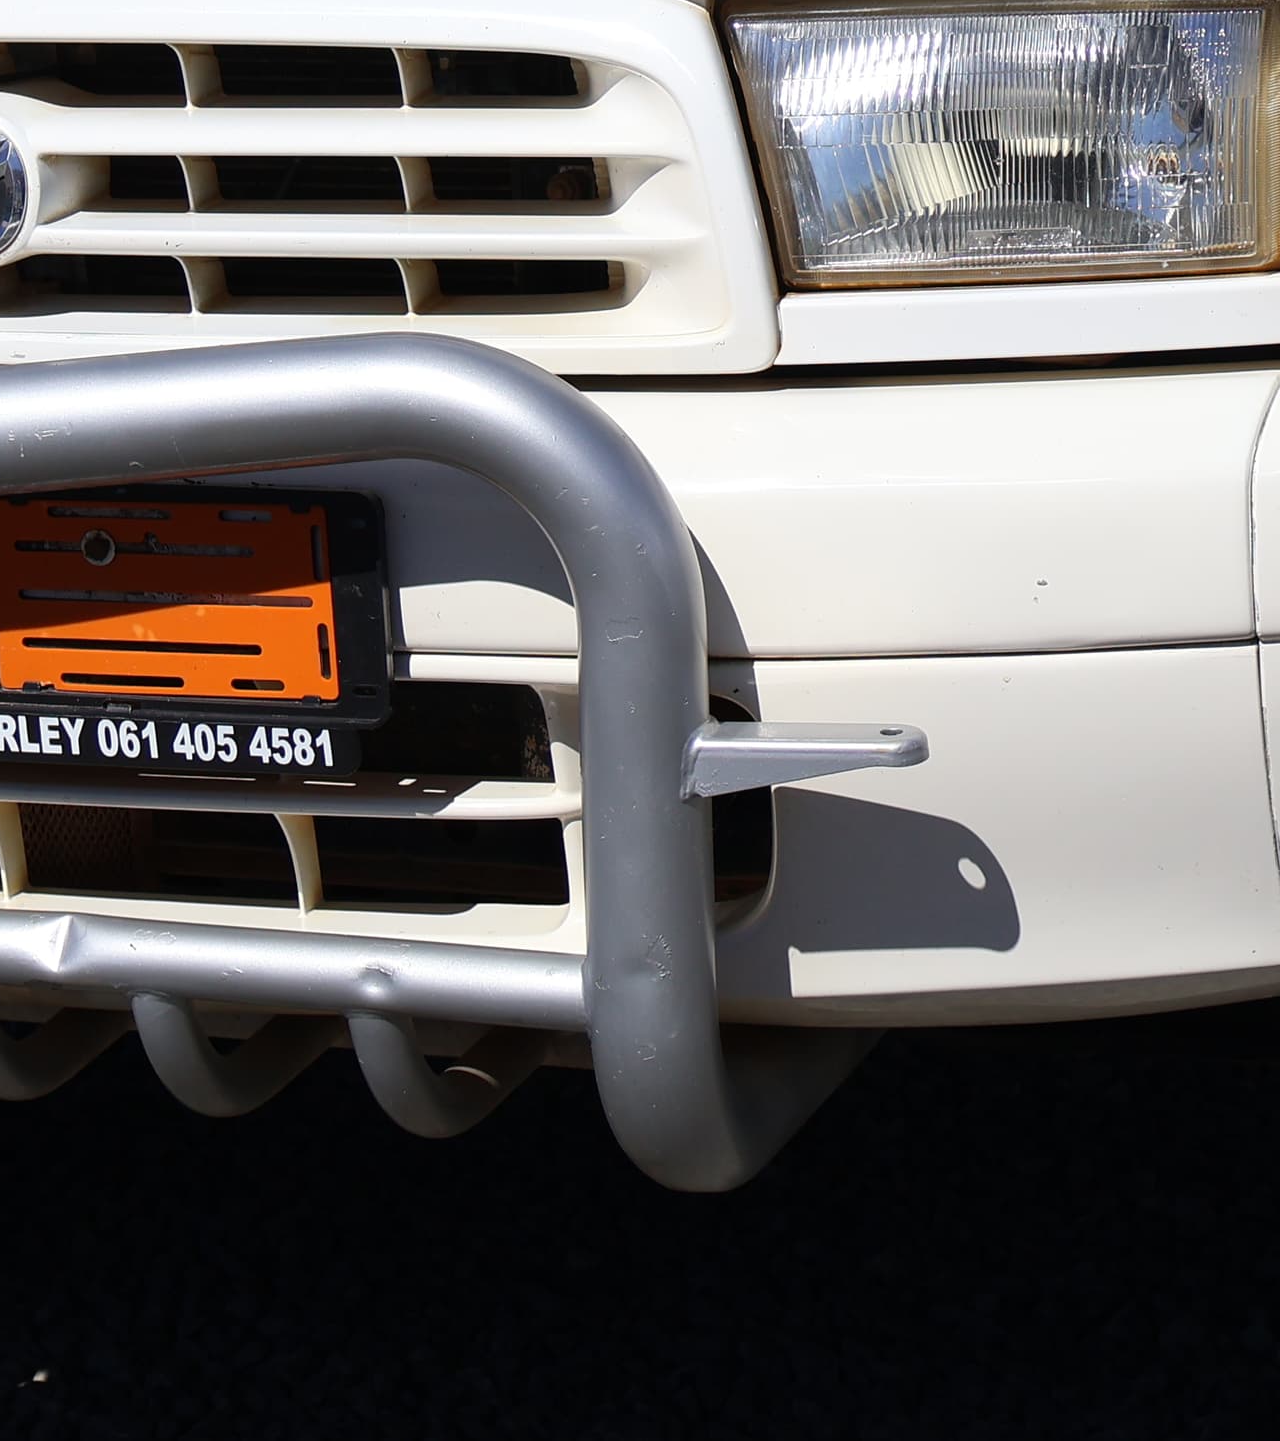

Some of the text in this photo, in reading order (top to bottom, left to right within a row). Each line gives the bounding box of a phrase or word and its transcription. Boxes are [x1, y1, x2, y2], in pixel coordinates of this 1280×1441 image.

[97, 719, 159, 758] 061
[173, 723, 238, 763] 405
[249, 726, 334, 767] 4581
